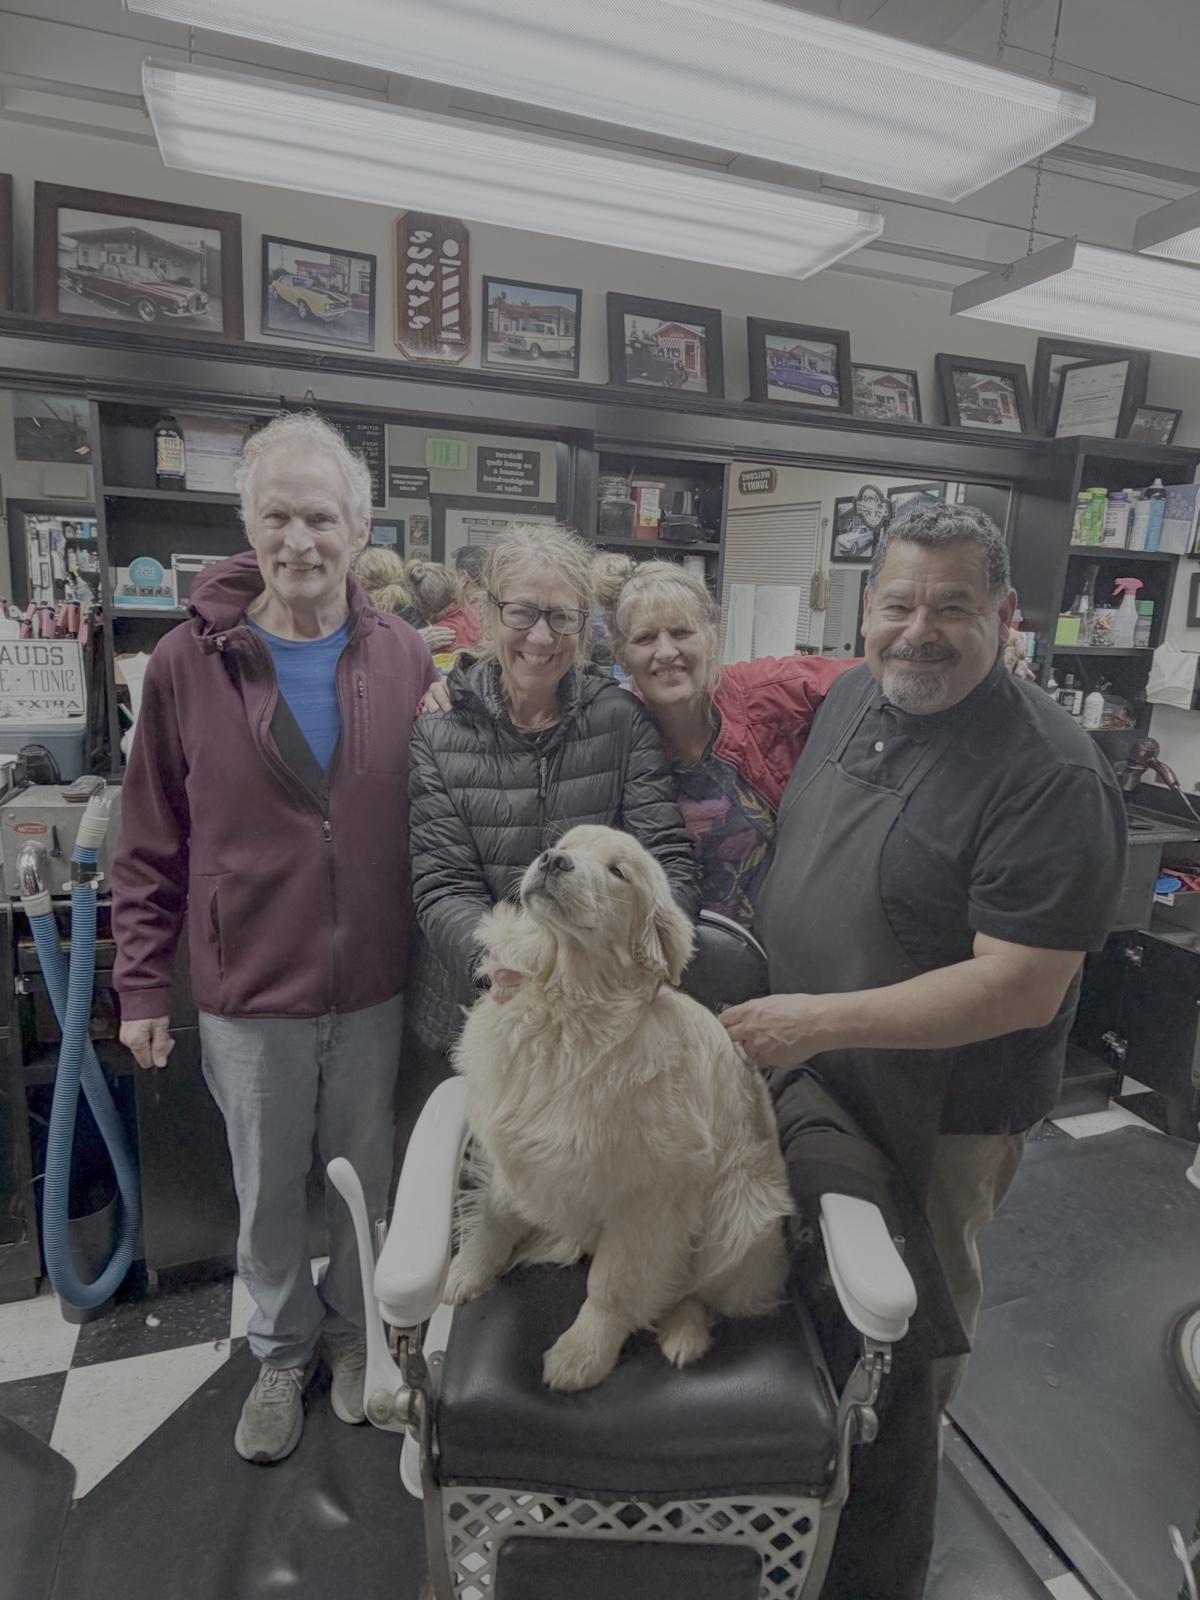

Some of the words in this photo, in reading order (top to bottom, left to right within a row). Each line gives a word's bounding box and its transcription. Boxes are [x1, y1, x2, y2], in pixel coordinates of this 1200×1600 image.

[406, 230, 436, 330] SUNNY'S
[28, 669, 76, 692] TONIC
[16, 699, 81, 709] EXTRA
